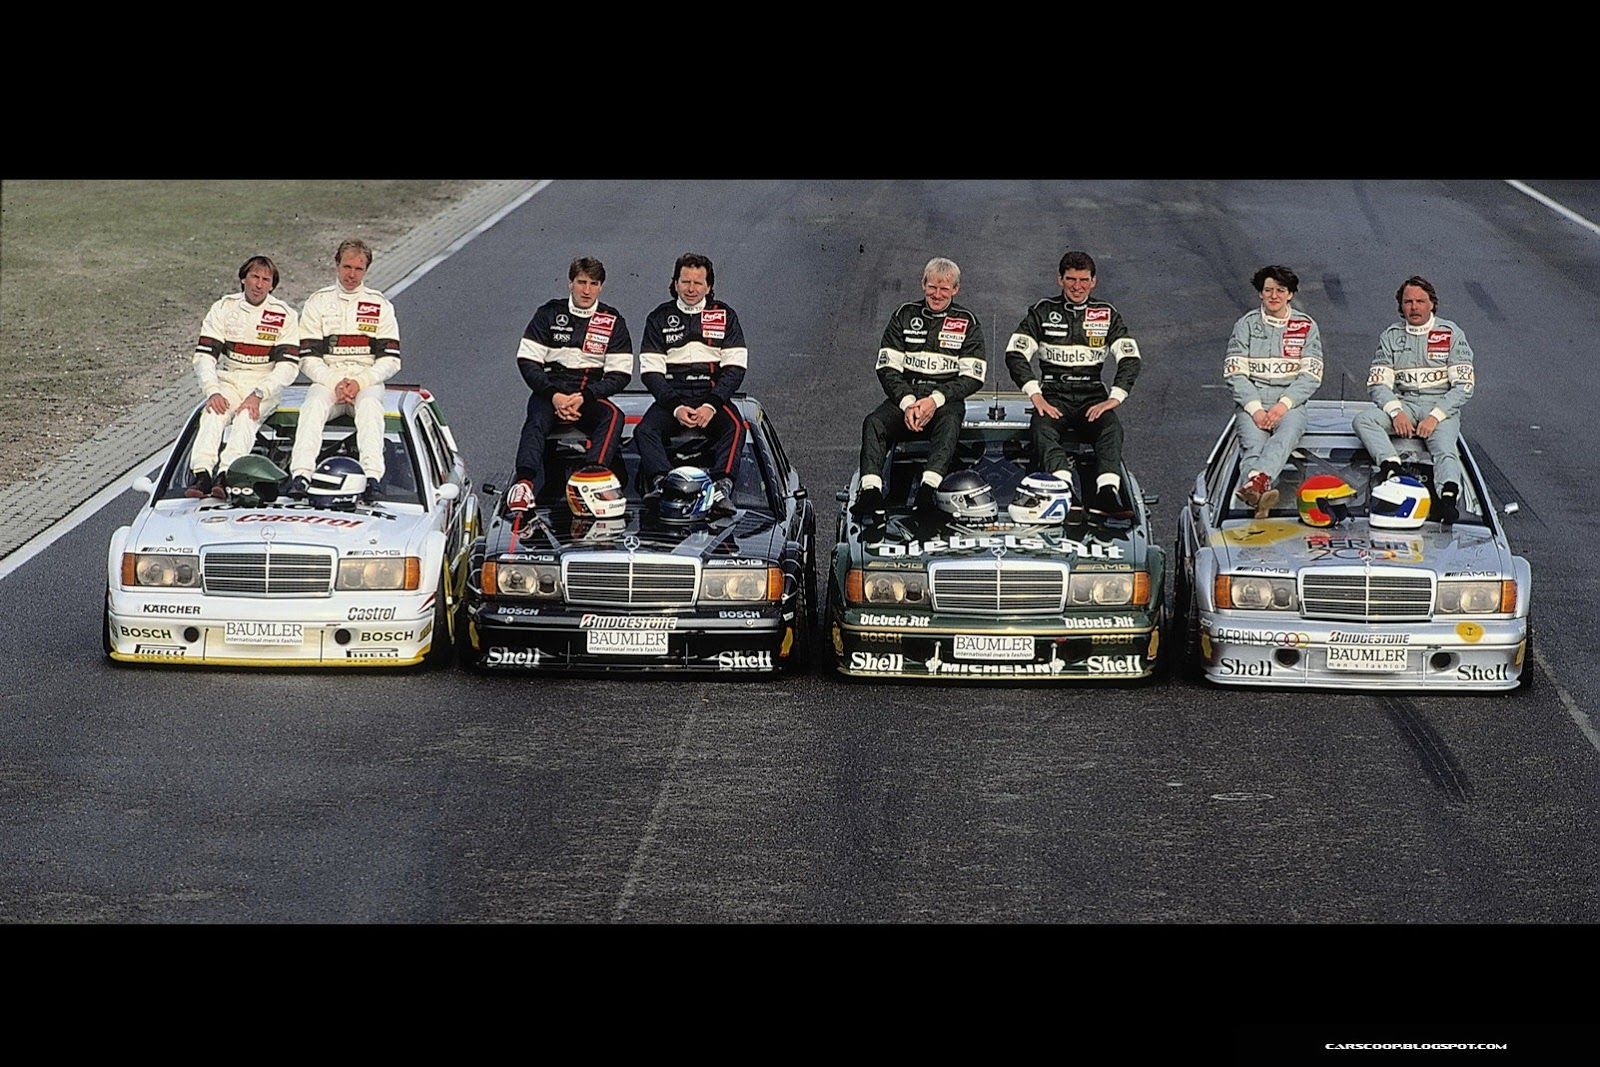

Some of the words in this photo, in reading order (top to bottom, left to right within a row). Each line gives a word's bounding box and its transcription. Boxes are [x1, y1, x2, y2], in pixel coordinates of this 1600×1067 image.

[347, 606, 396, 621] Castrol
[497, 607, 539, 615] BOSCH
[581, 614, 678, 629] BRIDGESTONE
[120, 626, 172, 639] BOSCH
[360, 631, 413, 642] BOSCH
[1329, 630, 1410, 644] BRIDGESTONE
[955, 636, 1033, 651] BÄUMLER
[486, 646, 540, 665] Shell
[719, 650, 773, 669] Shell
[849, 652, 904, 671] Shell
[941, 662, 1050, 674] MICHELIN
[1087, 655, 1143, 674] Shell
[1219, 658, 1273, 677] Shell
[1456, 663, 1508, 681] Shell
